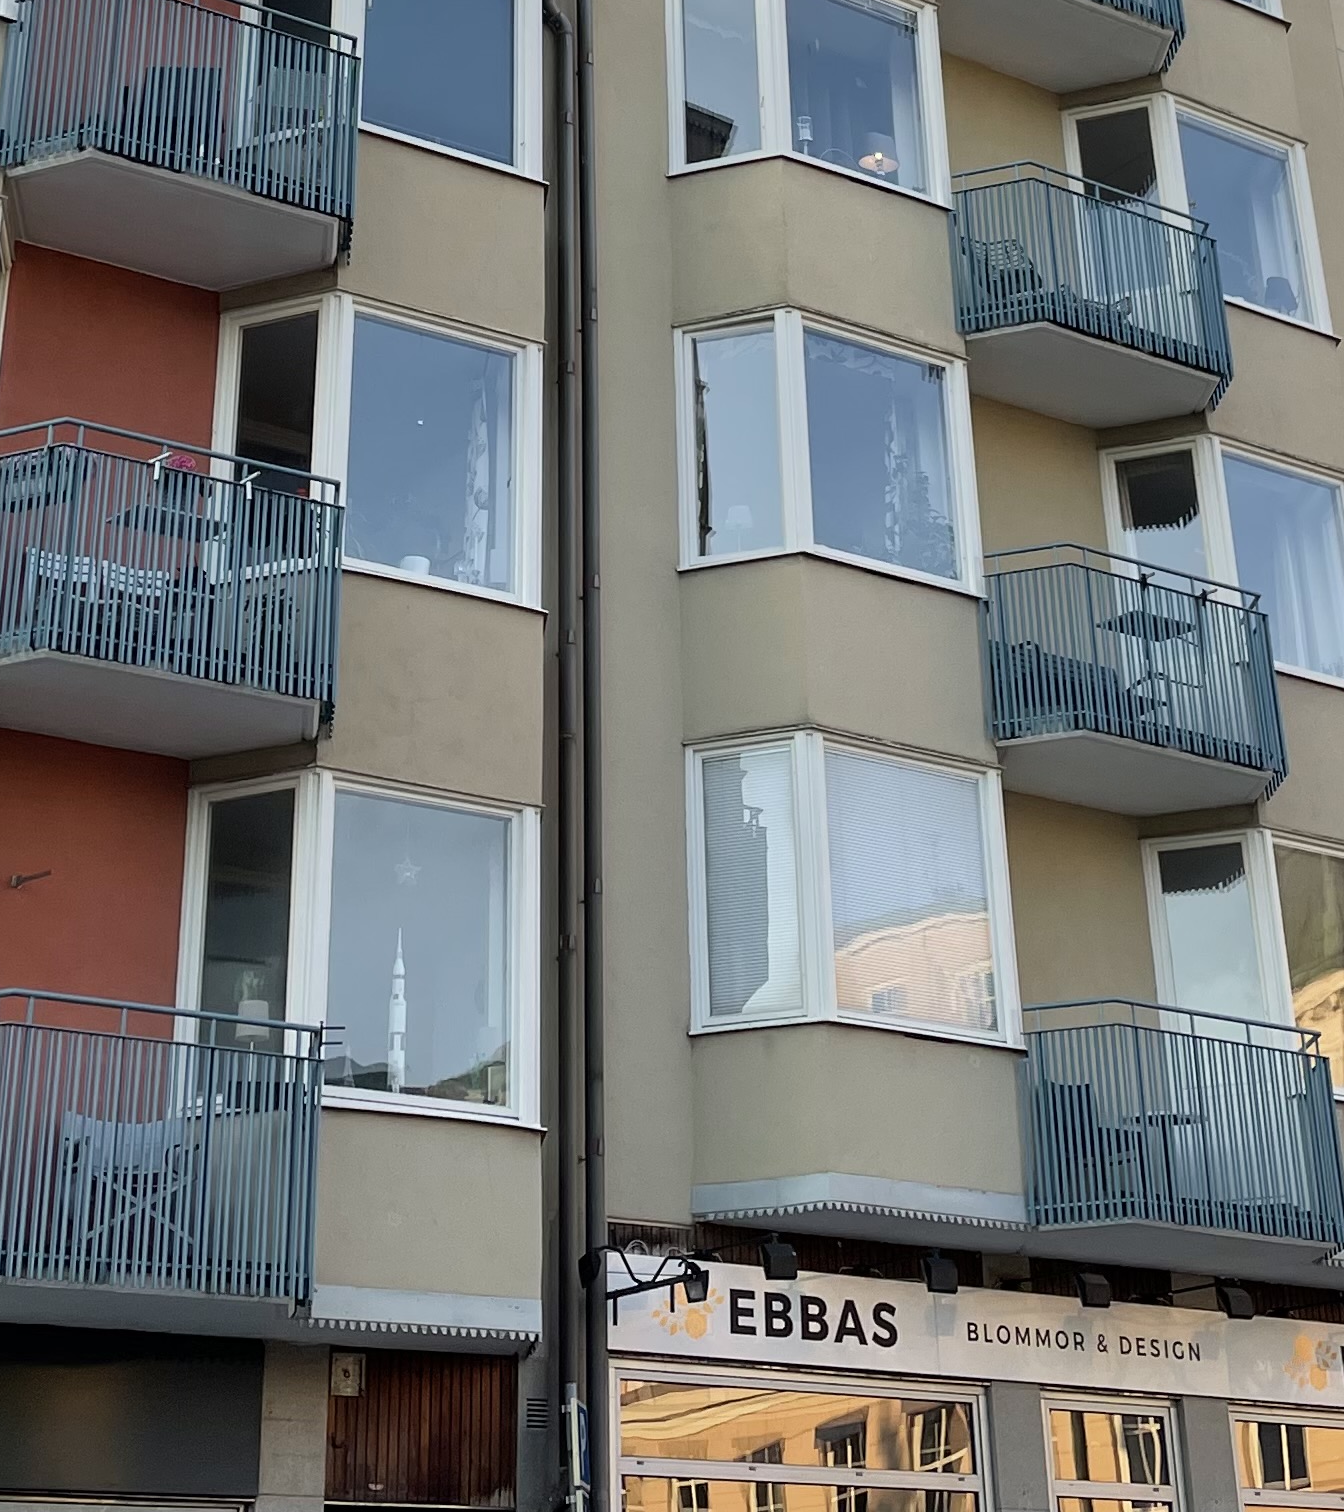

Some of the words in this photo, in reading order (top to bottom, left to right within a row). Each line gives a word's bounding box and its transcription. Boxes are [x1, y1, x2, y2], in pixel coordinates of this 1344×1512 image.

[729, 1288, 898, 1348] EBBAS
[967, 1322, 1085, 1352] BLOMMOR
[1097, 1333, 1108, 1353] &
[1119, 1336, 1201, 1362] DESIGN
